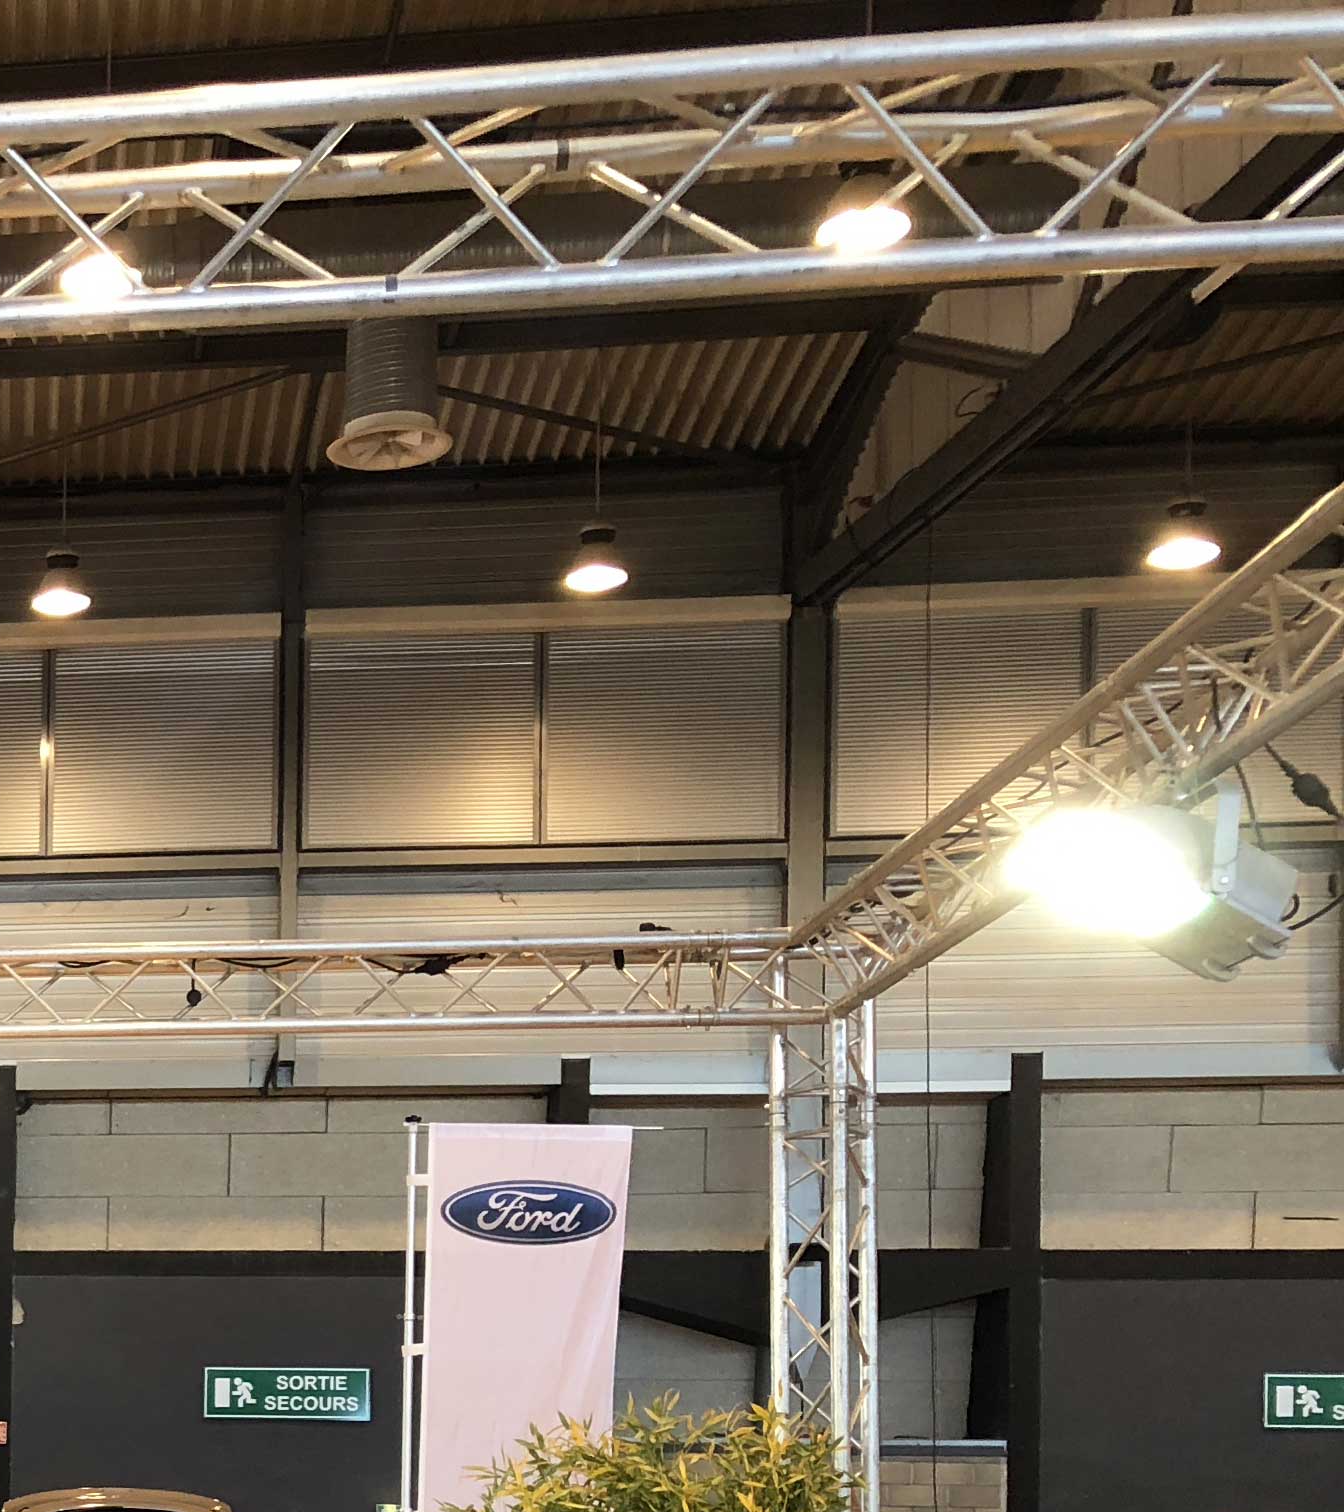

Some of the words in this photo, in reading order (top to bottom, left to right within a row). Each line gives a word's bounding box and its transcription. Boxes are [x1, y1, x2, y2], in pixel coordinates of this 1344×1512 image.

[476, 1190, 585, 1233] Ford
[275, 1375, 348, 1391] SORTIE
[263, 1395, 359, 1412] SECOURS
